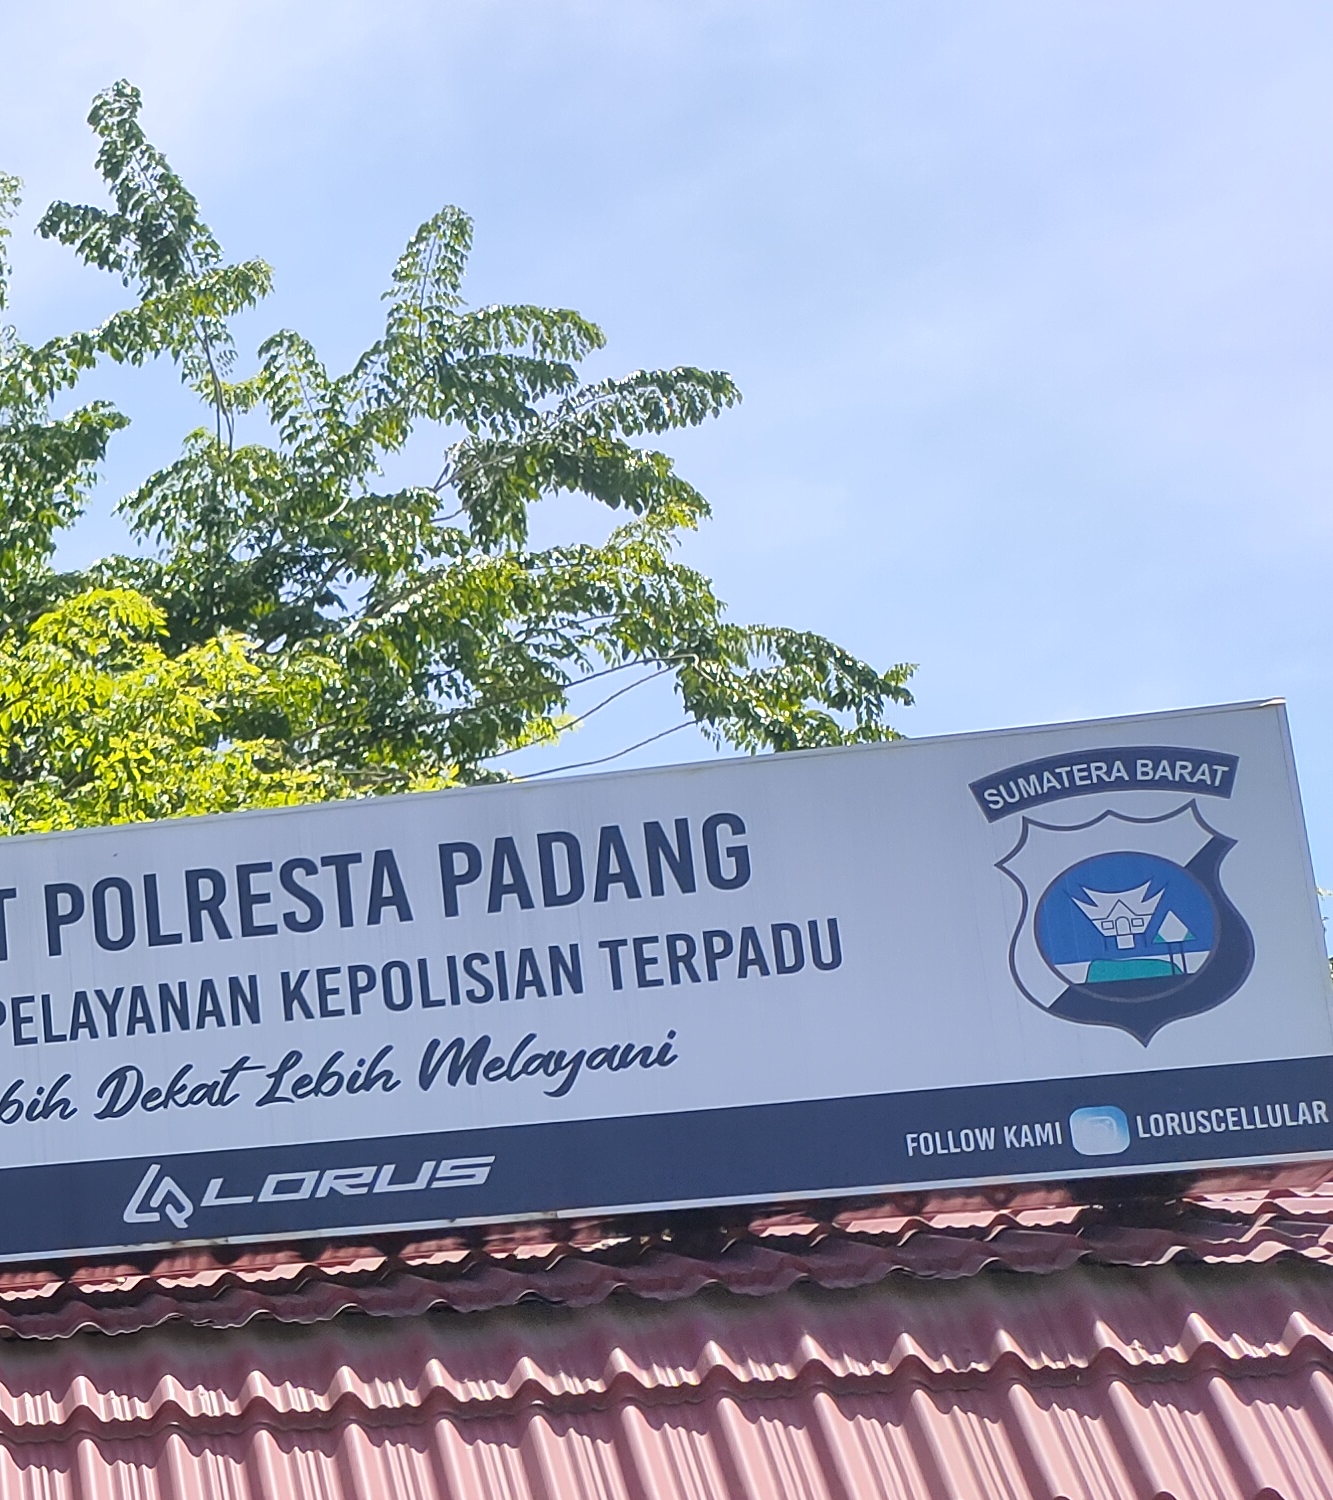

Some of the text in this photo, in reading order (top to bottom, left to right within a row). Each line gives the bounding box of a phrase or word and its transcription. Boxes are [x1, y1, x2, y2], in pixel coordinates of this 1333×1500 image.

[983, 758, 1230, 811] SUMATERA BARAT
[44, 848, 414, 958] POLRESTA
[438, 810, 753, 917] PADANG
[279, 943, 586, 1022] KEPOLISIAN
[597, 917, 844, 991] TERPADU
[94, 1056, 251, 1121] Dekat
[254, 1042, 403, 1106] Lebih
[417, 1029, 679, 1097] Melayani
[905, 1100, 1331, 1158] FOLLOW KAMI LORUSCELLULAR
[199, 1153, 496, 1206] LORUS
